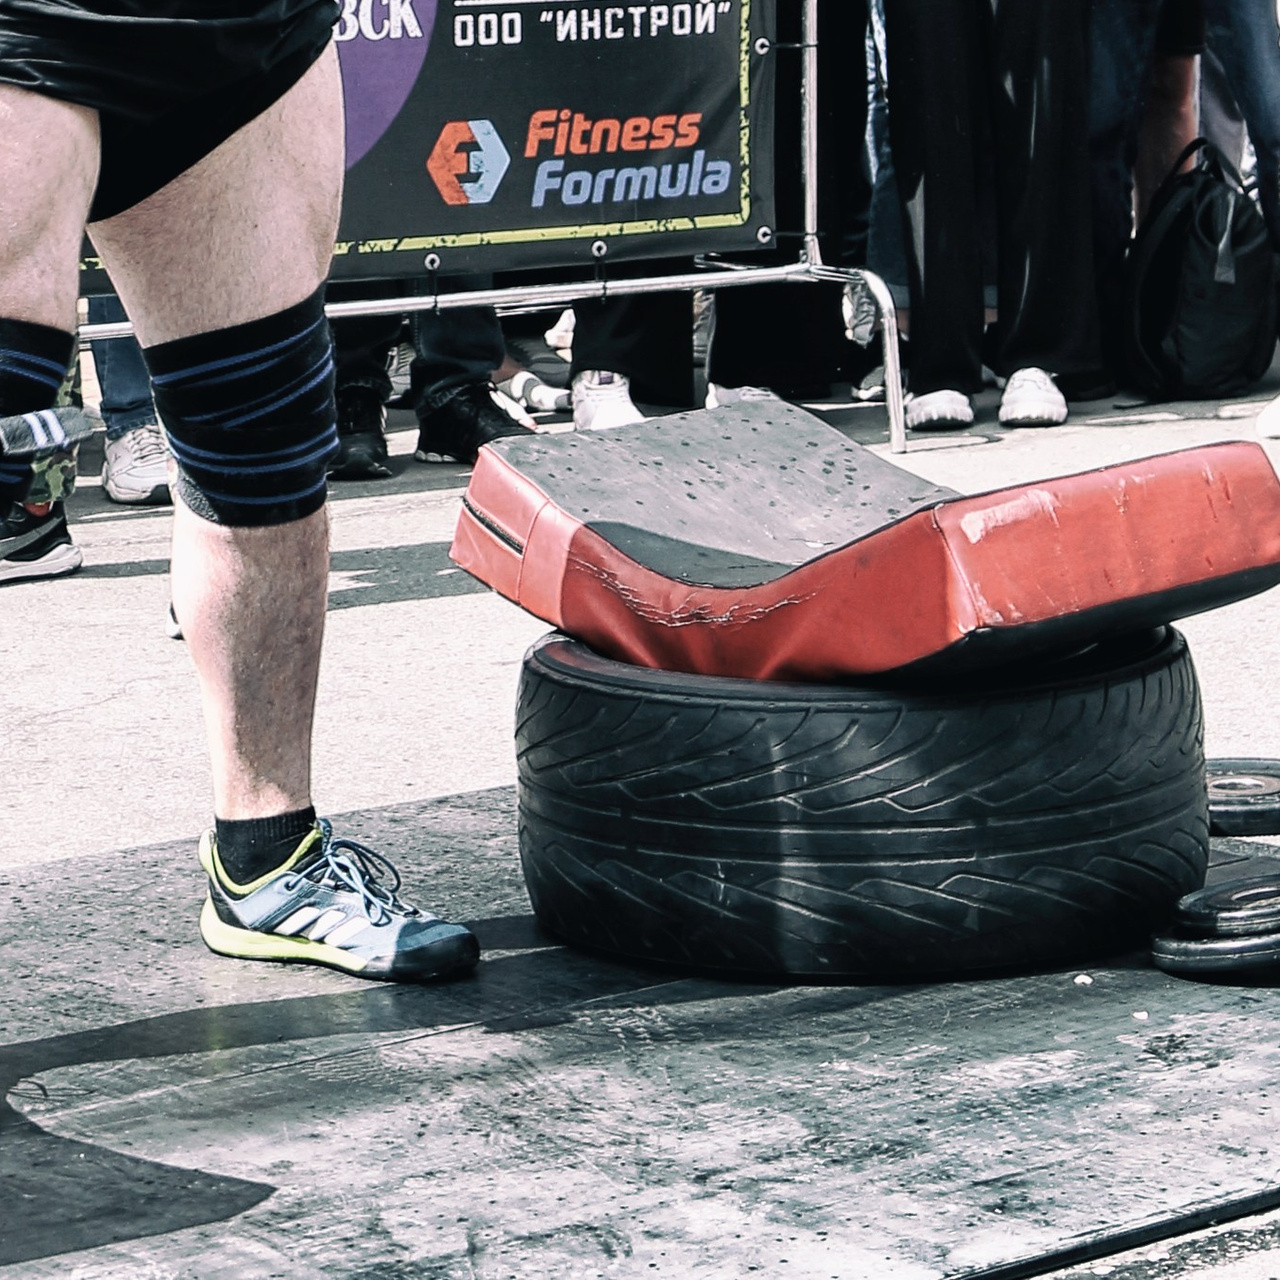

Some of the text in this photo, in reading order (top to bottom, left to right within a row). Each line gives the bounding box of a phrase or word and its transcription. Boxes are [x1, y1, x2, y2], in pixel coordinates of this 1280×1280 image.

[454, 11, 523, 48] ООО
[523, 108, 704, 159] Fitness
[530, 148, 732, 208] Formula
